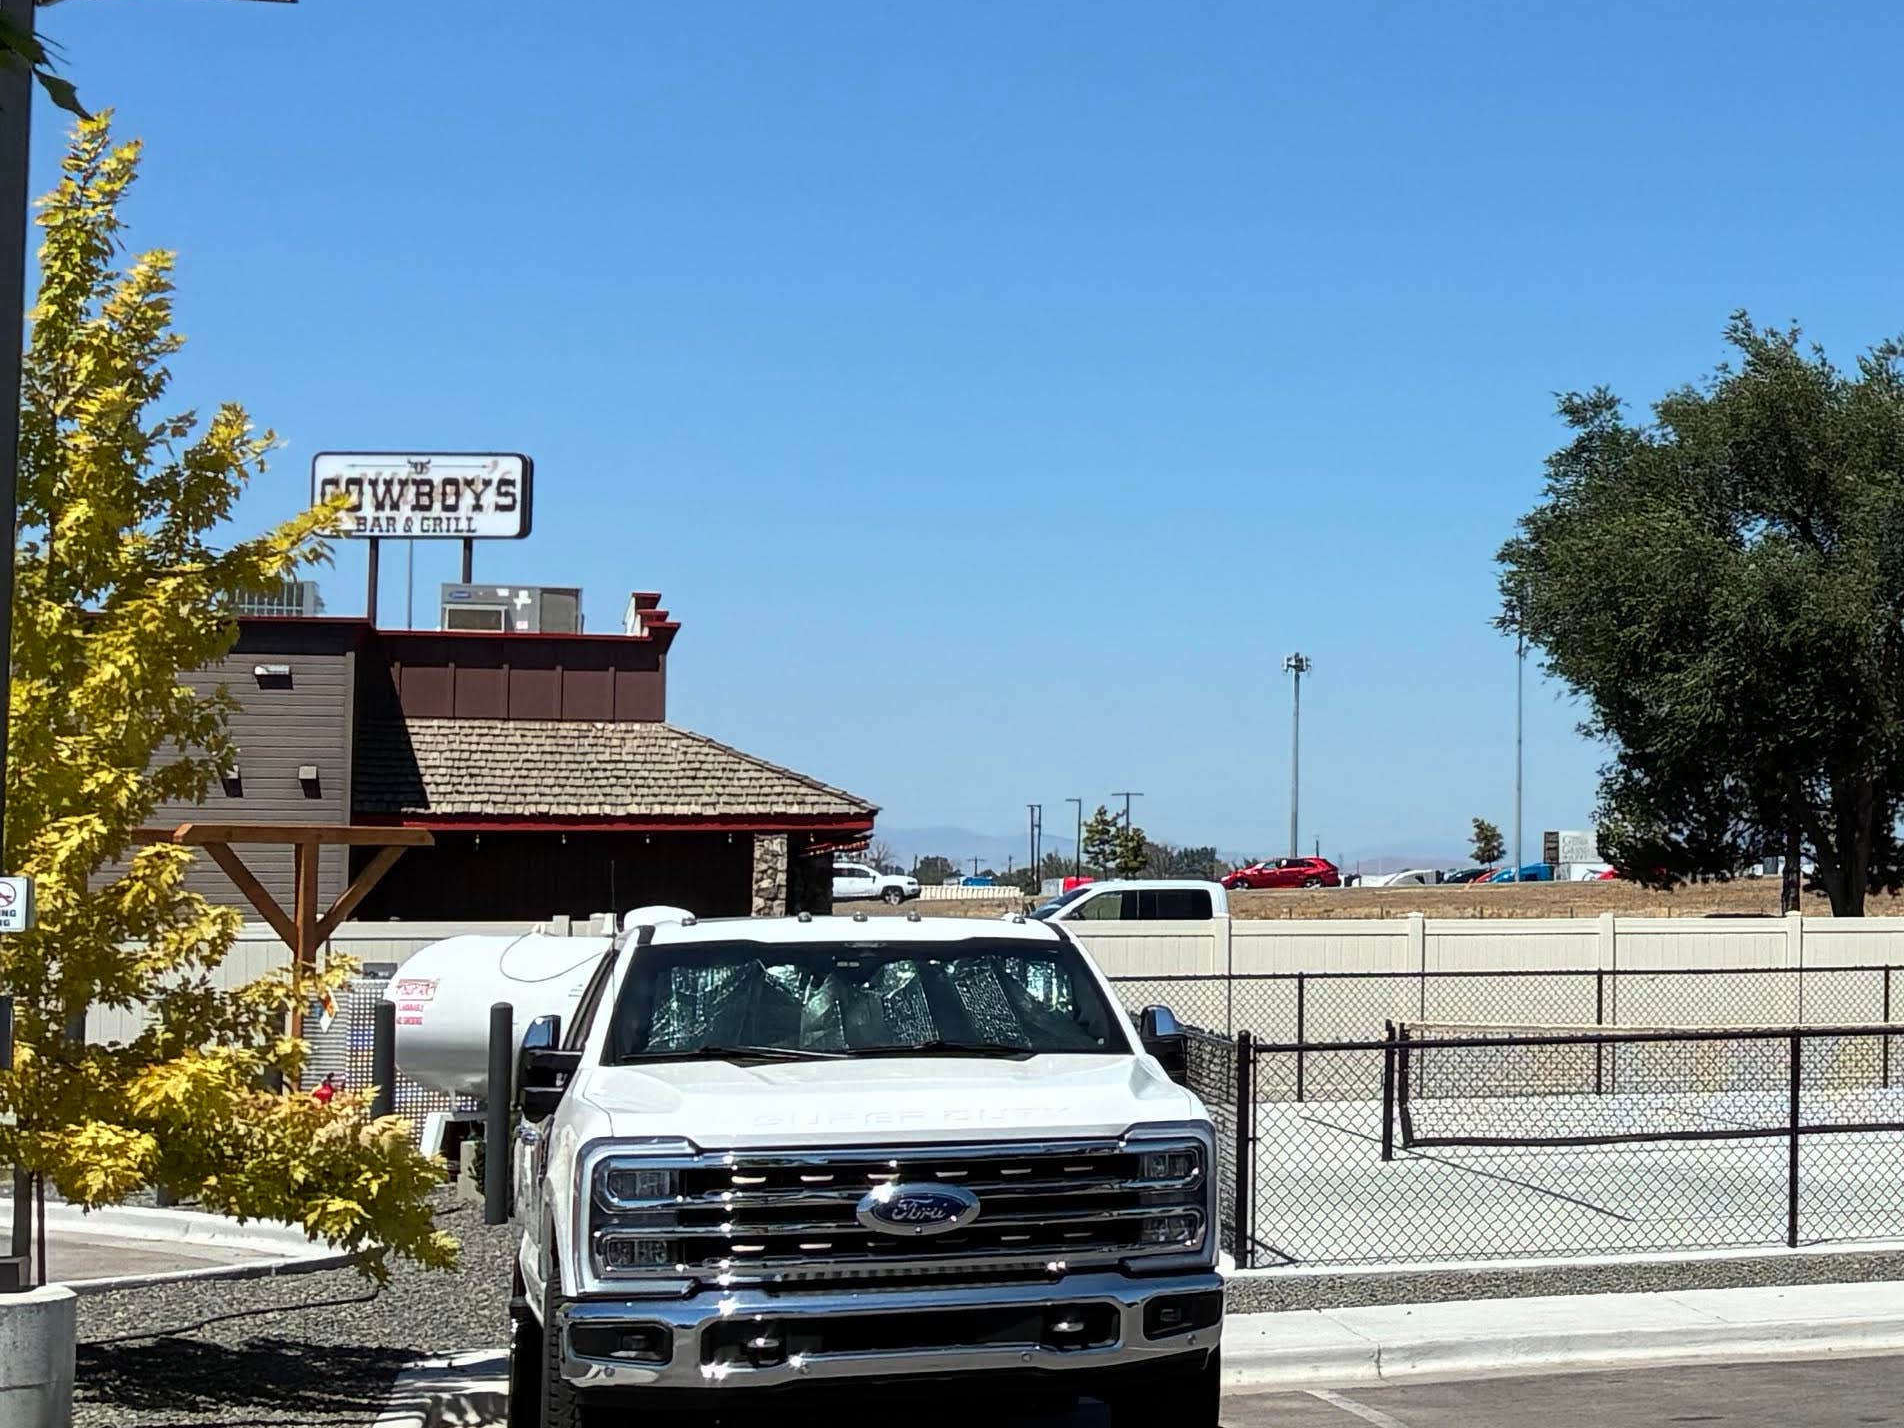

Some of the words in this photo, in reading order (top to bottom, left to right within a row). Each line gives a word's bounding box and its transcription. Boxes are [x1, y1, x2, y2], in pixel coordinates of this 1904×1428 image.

[321, 477, 517, 512] COWBOYS
[356, 516, 397, 533] BAR
[403, 516, 414, 533] &
[420, 516, 477, 533] GRILL
[891, 1198, 946, 1221] Ford
